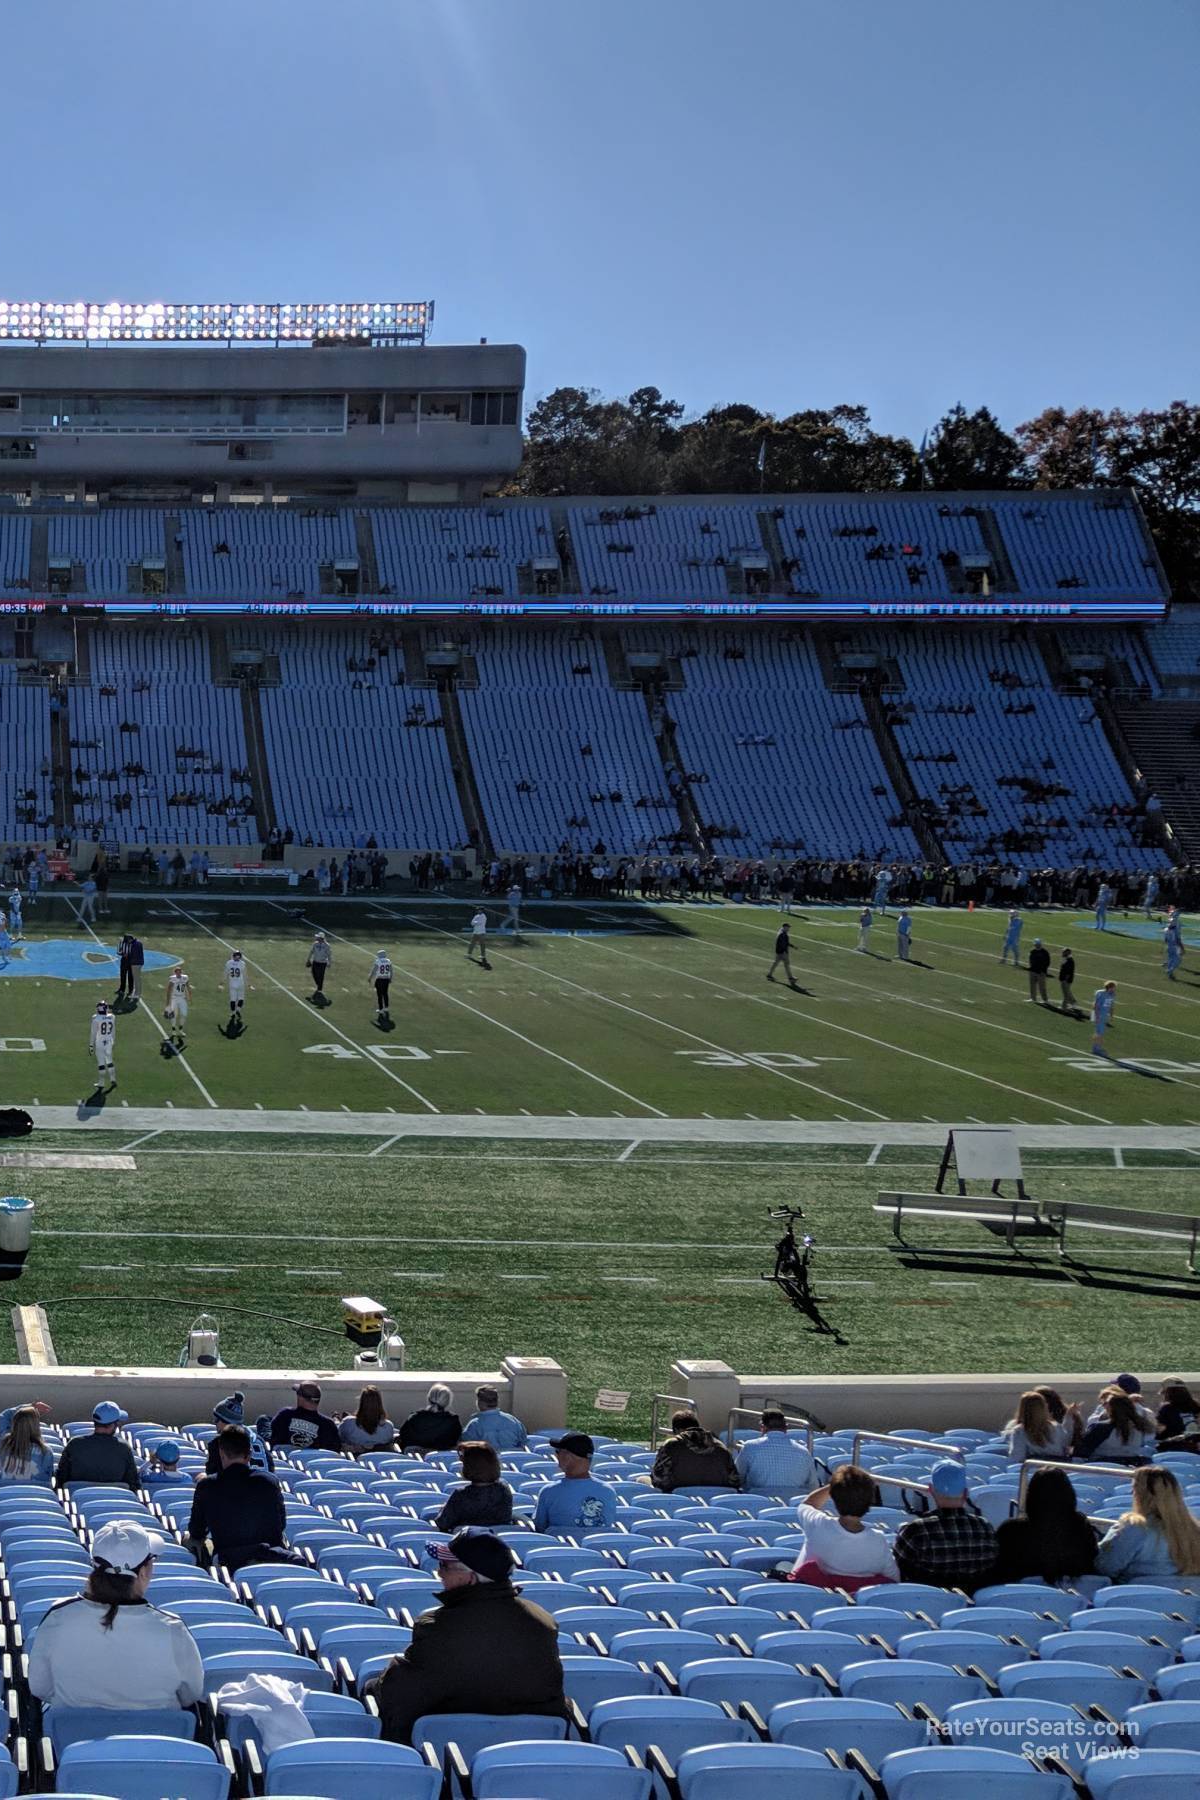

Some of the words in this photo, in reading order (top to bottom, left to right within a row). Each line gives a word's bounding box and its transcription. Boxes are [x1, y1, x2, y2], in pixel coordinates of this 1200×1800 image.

[0, 603, 27, 614] 49:35
[262, 604, 309, 615] PEPPERS
[869, 603, 931, 615] WELCOME
[939, 603, 954, 615] TO
[959, 603, 1003, 615] KENAN
[1008, 603, 1071, 615] STADIUM
[379, 964, 390, 976] 89
[100, 1022, 113, 1036] 83
[300, 1043, 433, 1060] 40
[674, 1050, 821, 1067] 30
